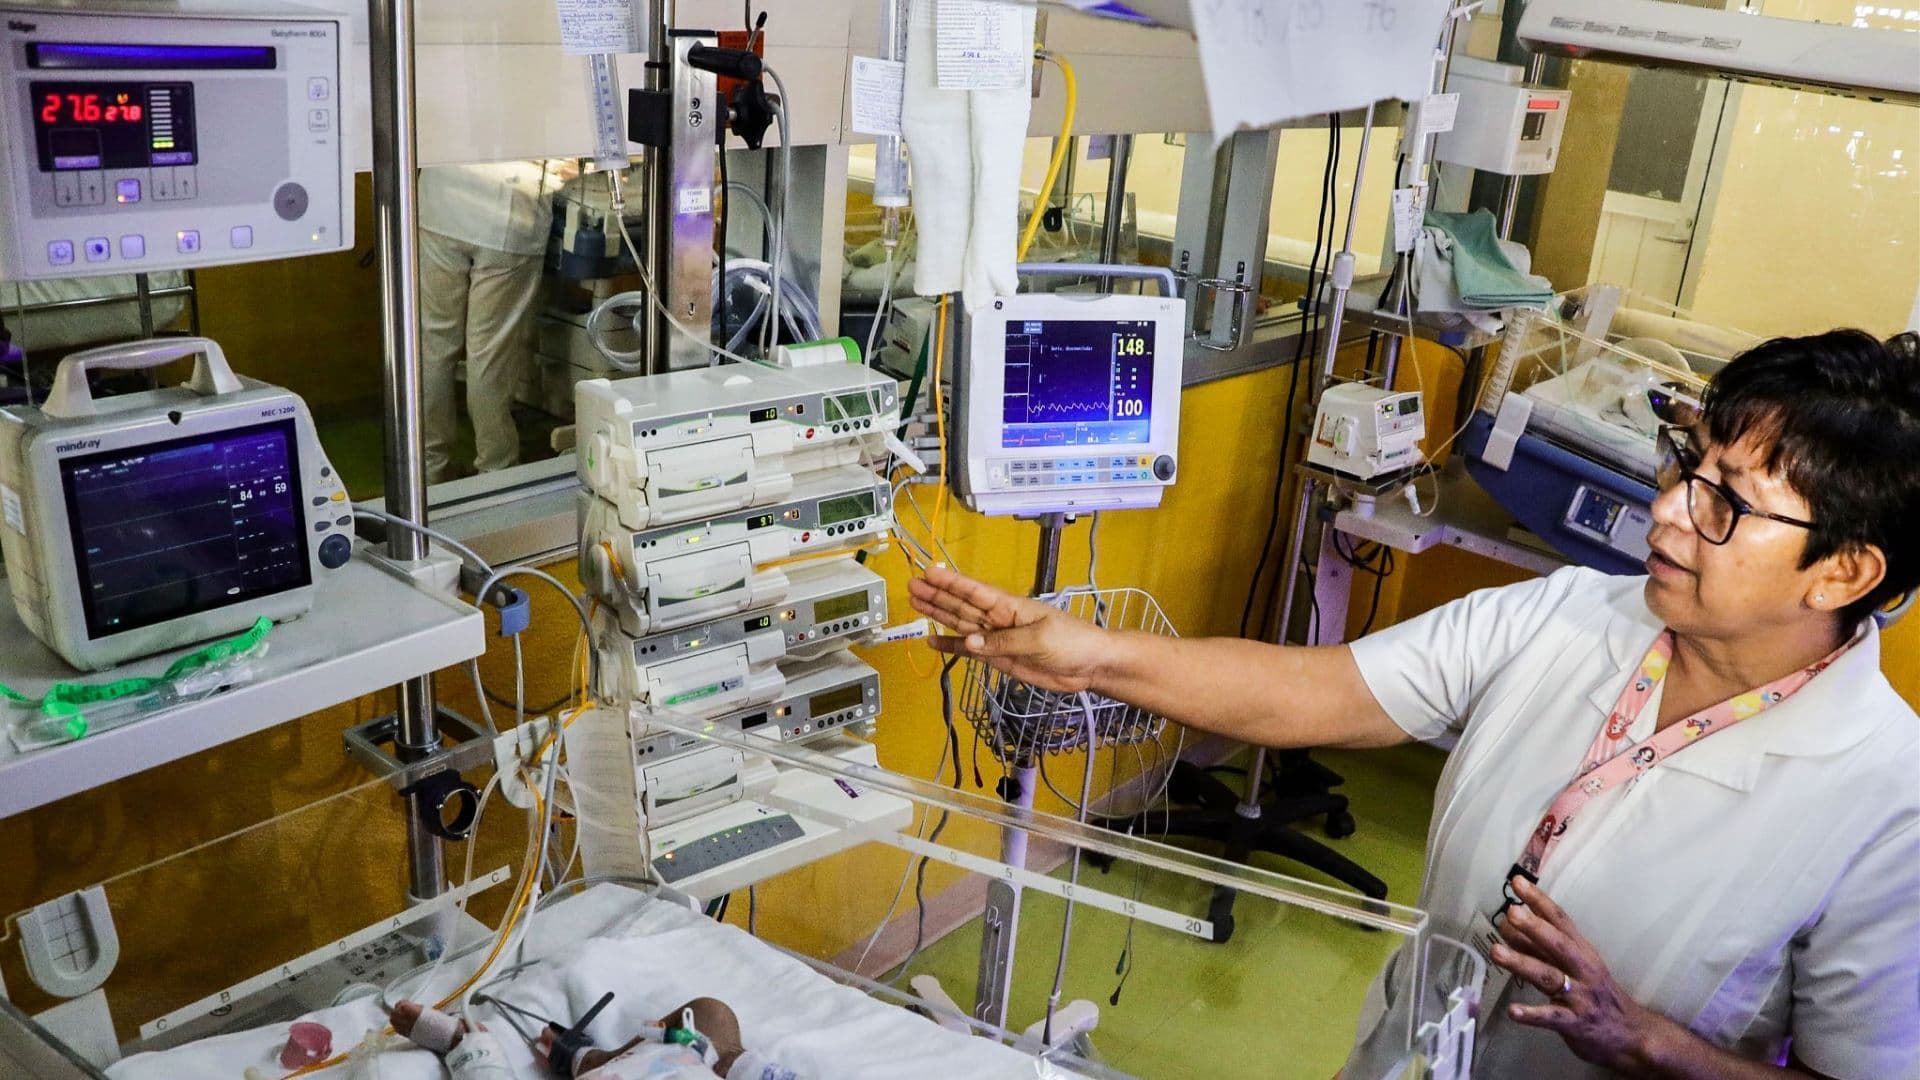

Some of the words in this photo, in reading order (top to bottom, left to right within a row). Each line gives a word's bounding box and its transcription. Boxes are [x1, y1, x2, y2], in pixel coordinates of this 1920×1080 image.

[1117, 338, 1144, 356] 148
[1116, 399, 1143, 417] 100
[56, 439, 101, 453] mindray
[240, 489, 252, 501] 84
[274, 482, 287, 494] 59
[1005, 867, 1013, 879] 5
[1061, 884, 1073, 897] 10
[1121, 901, 1136, 915] 15
[1185, 919, 1202, 934] 20
[156, 1018, 168, 1031] C
[220, 991, 231, 1004] B
[282, 965, 291, 977] A
[392, 917, 402, 930] A
[491, 872, 500, 883] C
